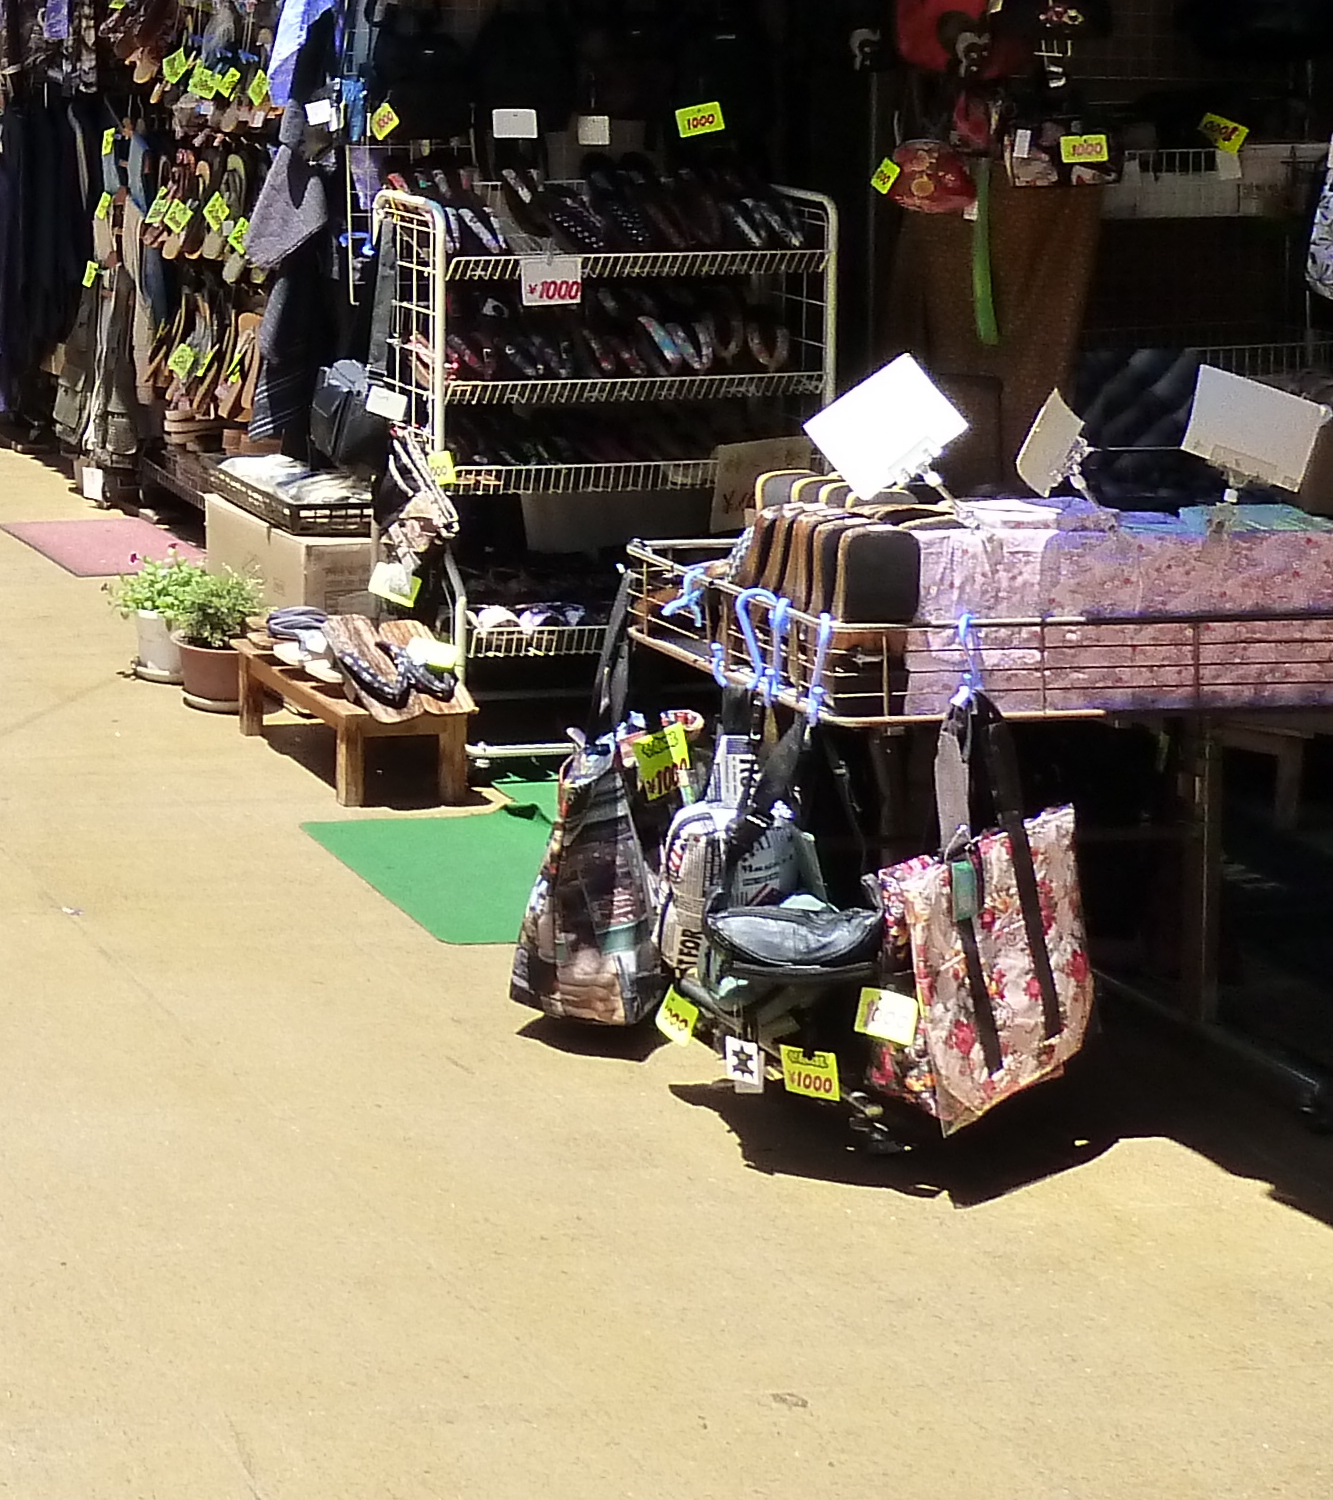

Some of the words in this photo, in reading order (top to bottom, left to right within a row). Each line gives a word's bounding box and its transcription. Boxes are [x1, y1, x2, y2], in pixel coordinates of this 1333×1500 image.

[686, 114, 715, 129] 1000
[527, 280, 582, 300] ¥1000
[788, 1069, 833, 1093] ¥1000
